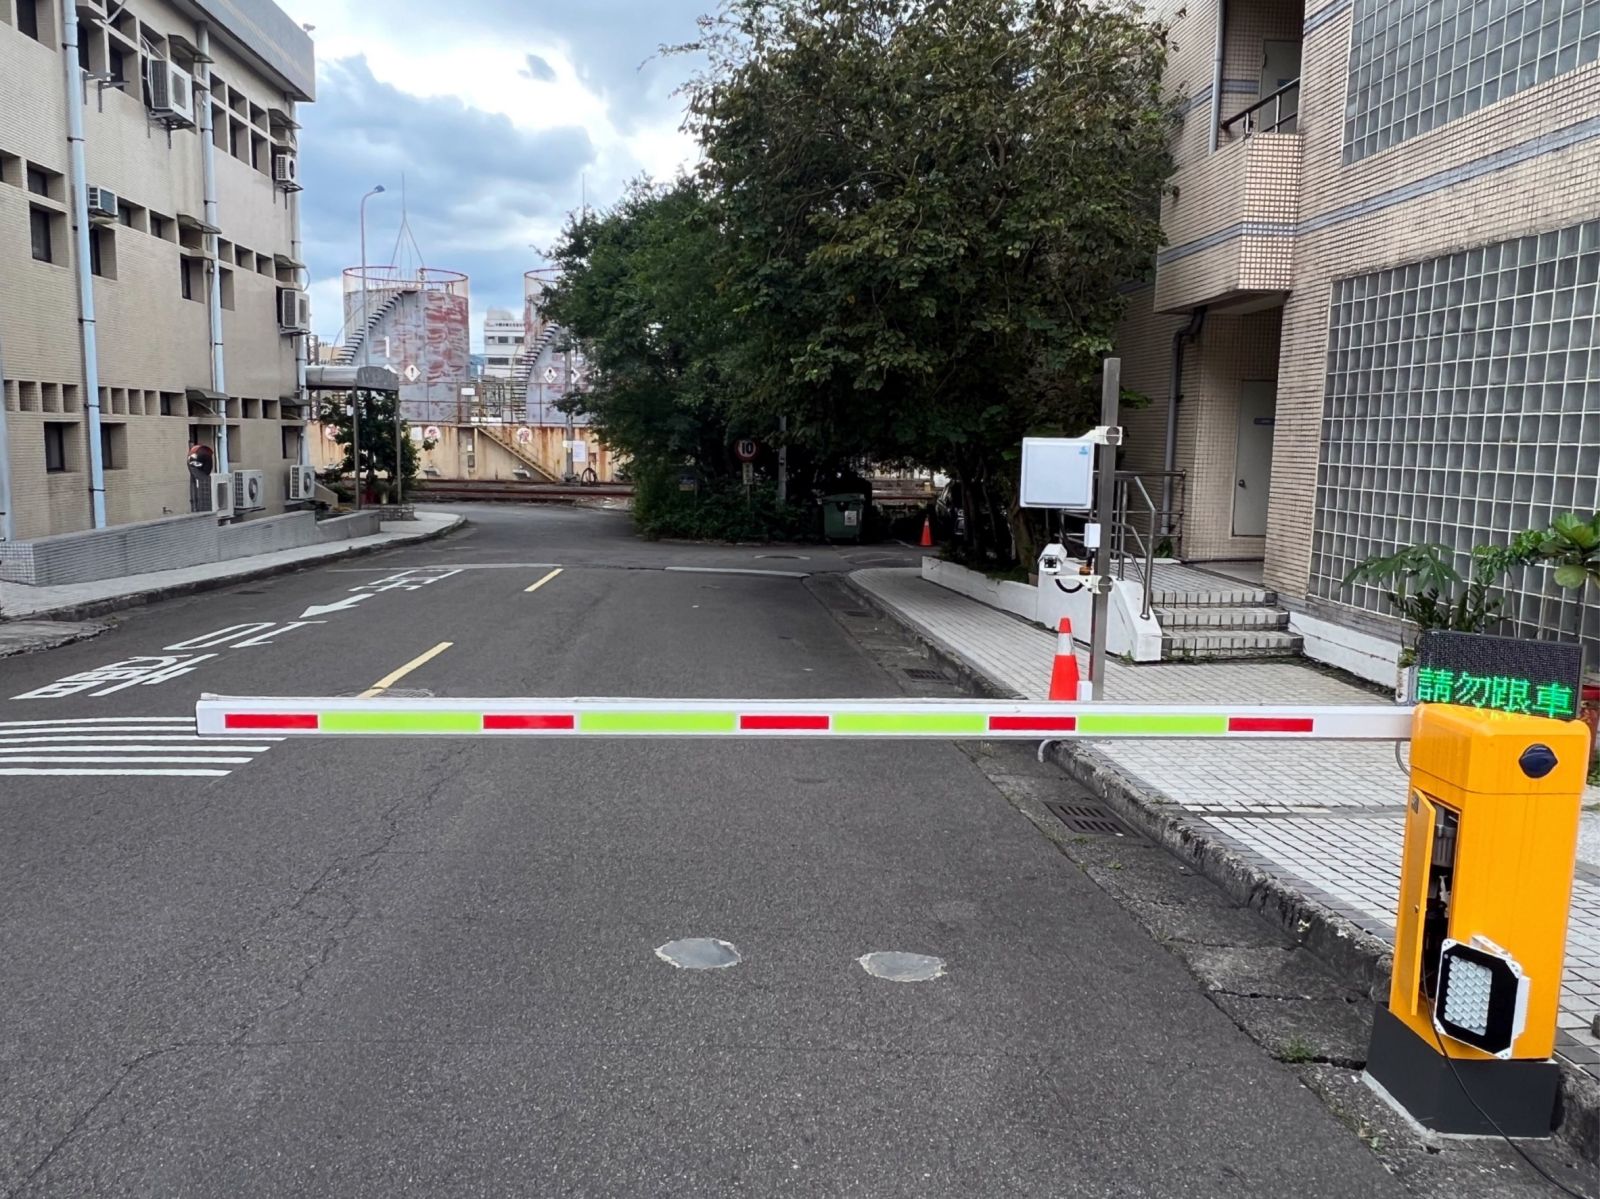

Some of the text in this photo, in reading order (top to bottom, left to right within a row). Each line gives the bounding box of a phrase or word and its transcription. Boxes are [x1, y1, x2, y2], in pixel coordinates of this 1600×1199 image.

[9, 652, 218, 700] 慢
[1417, 667, 1574, 718] 請勿跟車
